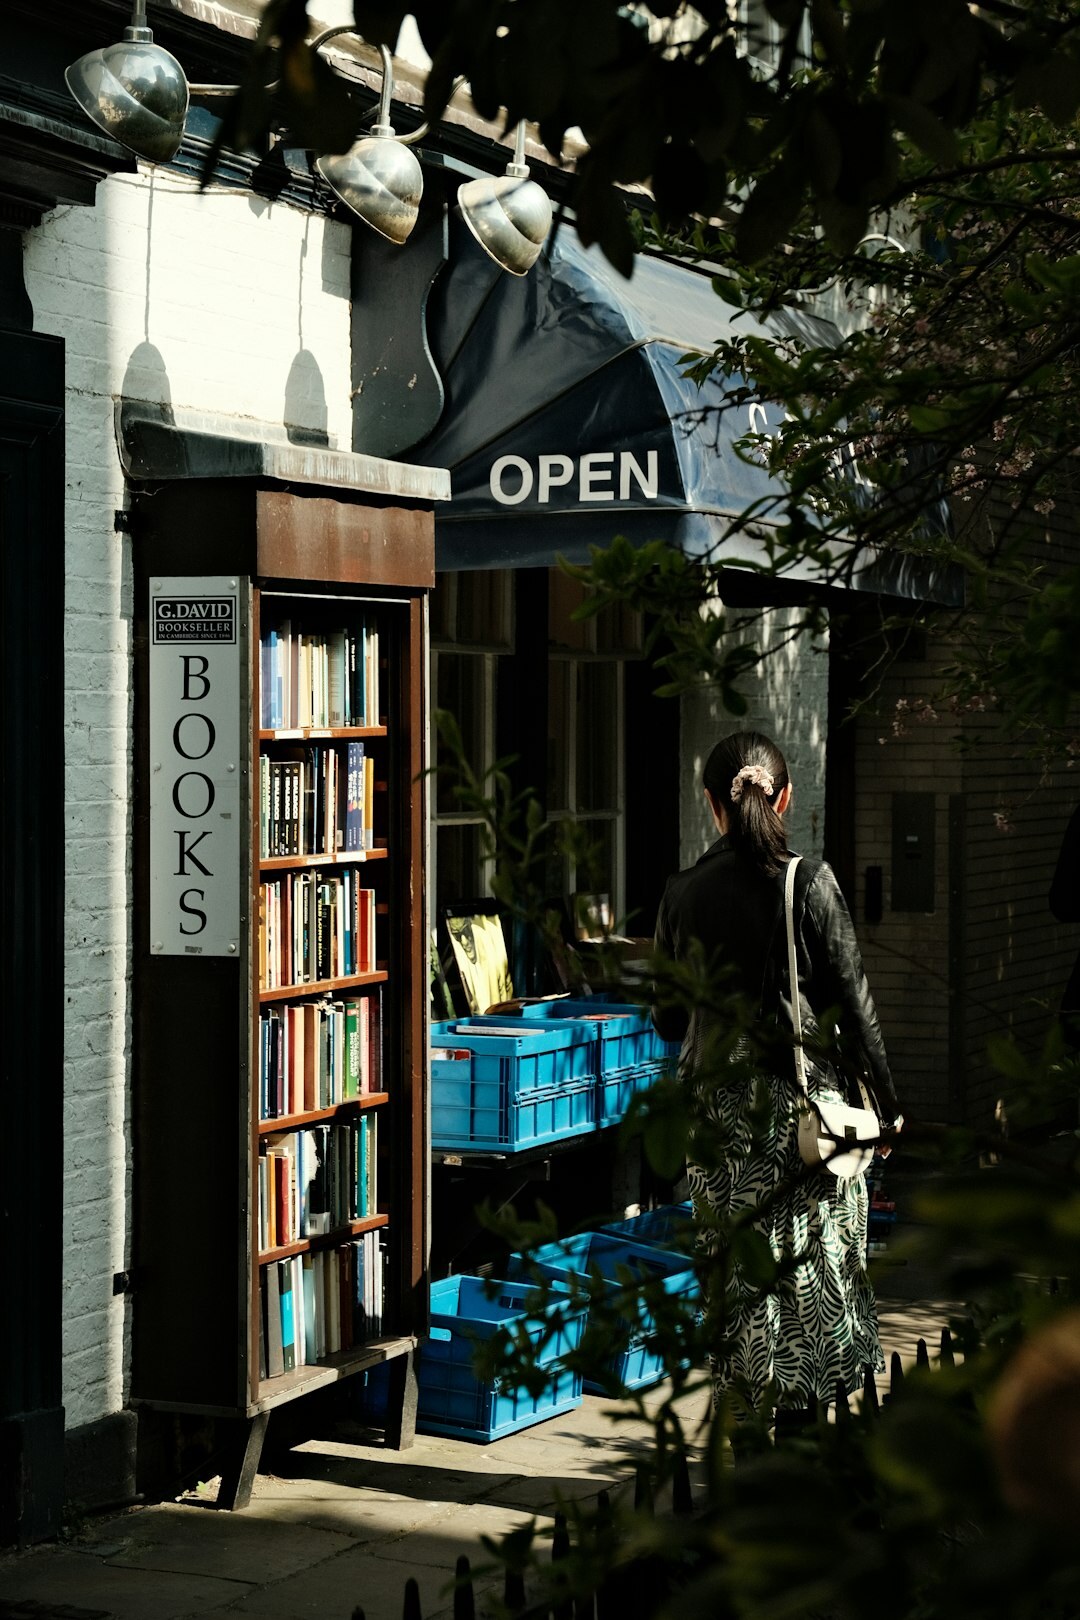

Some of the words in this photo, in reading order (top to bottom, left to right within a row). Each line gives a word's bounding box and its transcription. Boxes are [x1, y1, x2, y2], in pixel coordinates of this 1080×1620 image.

[490, 450, 658, 506] OPEN
[158, 603, 231, 618] G.DAVID
[158, 622, 230, 632] BOOKSELLER
[172, 655, 216, 935] BOOKS
